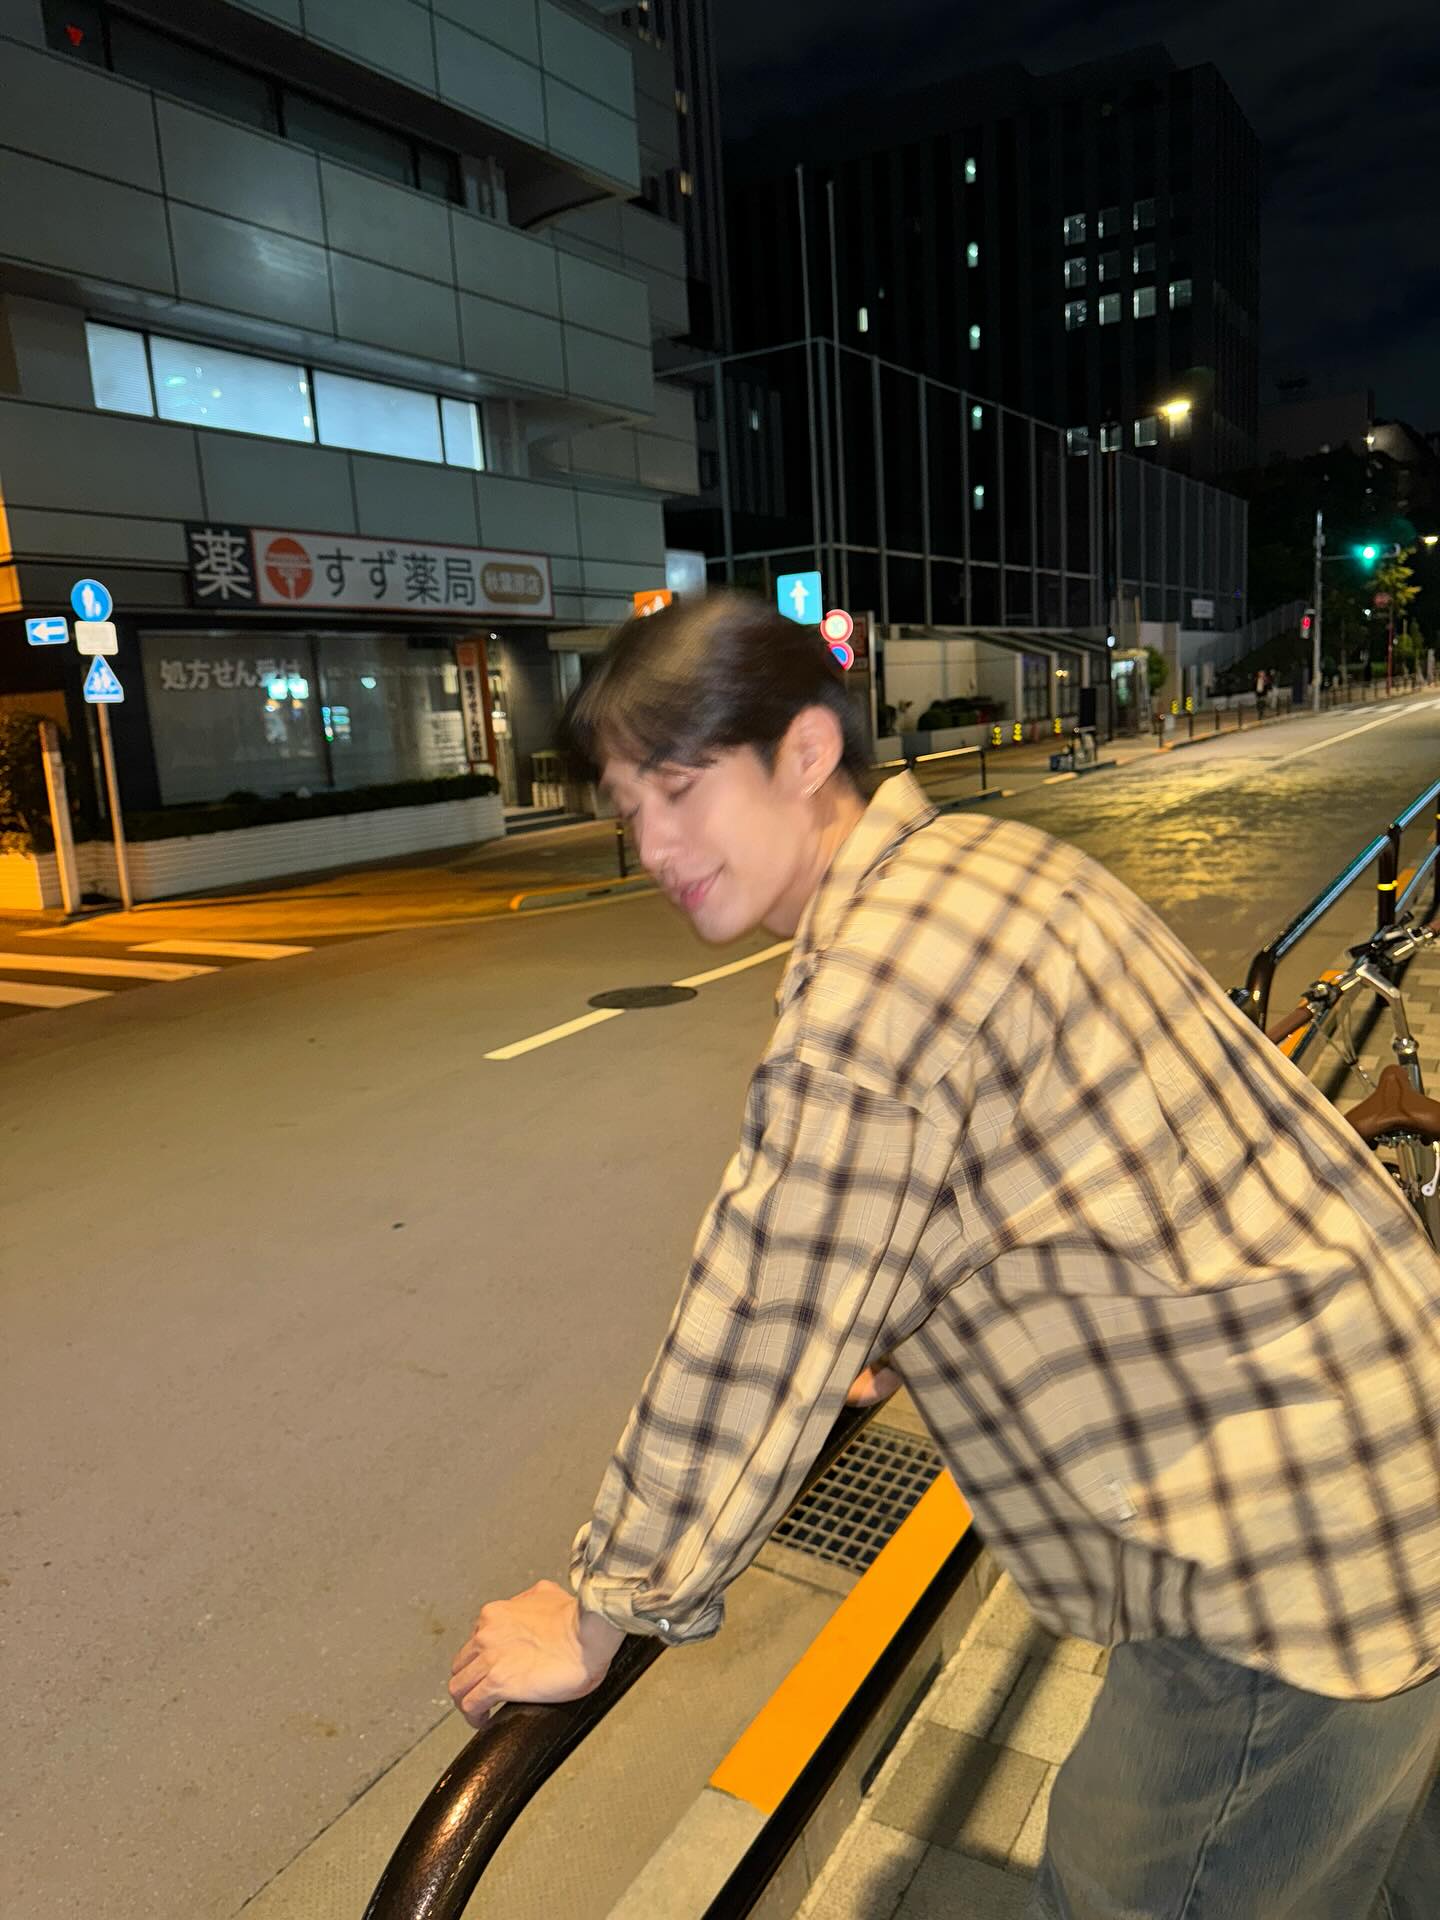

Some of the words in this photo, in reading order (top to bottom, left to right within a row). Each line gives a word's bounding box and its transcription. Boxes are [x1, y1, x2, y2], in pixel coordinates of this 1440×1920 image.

[190, 528, 252, 599] 薬
[317, 548, 476, 606] すず薬局
